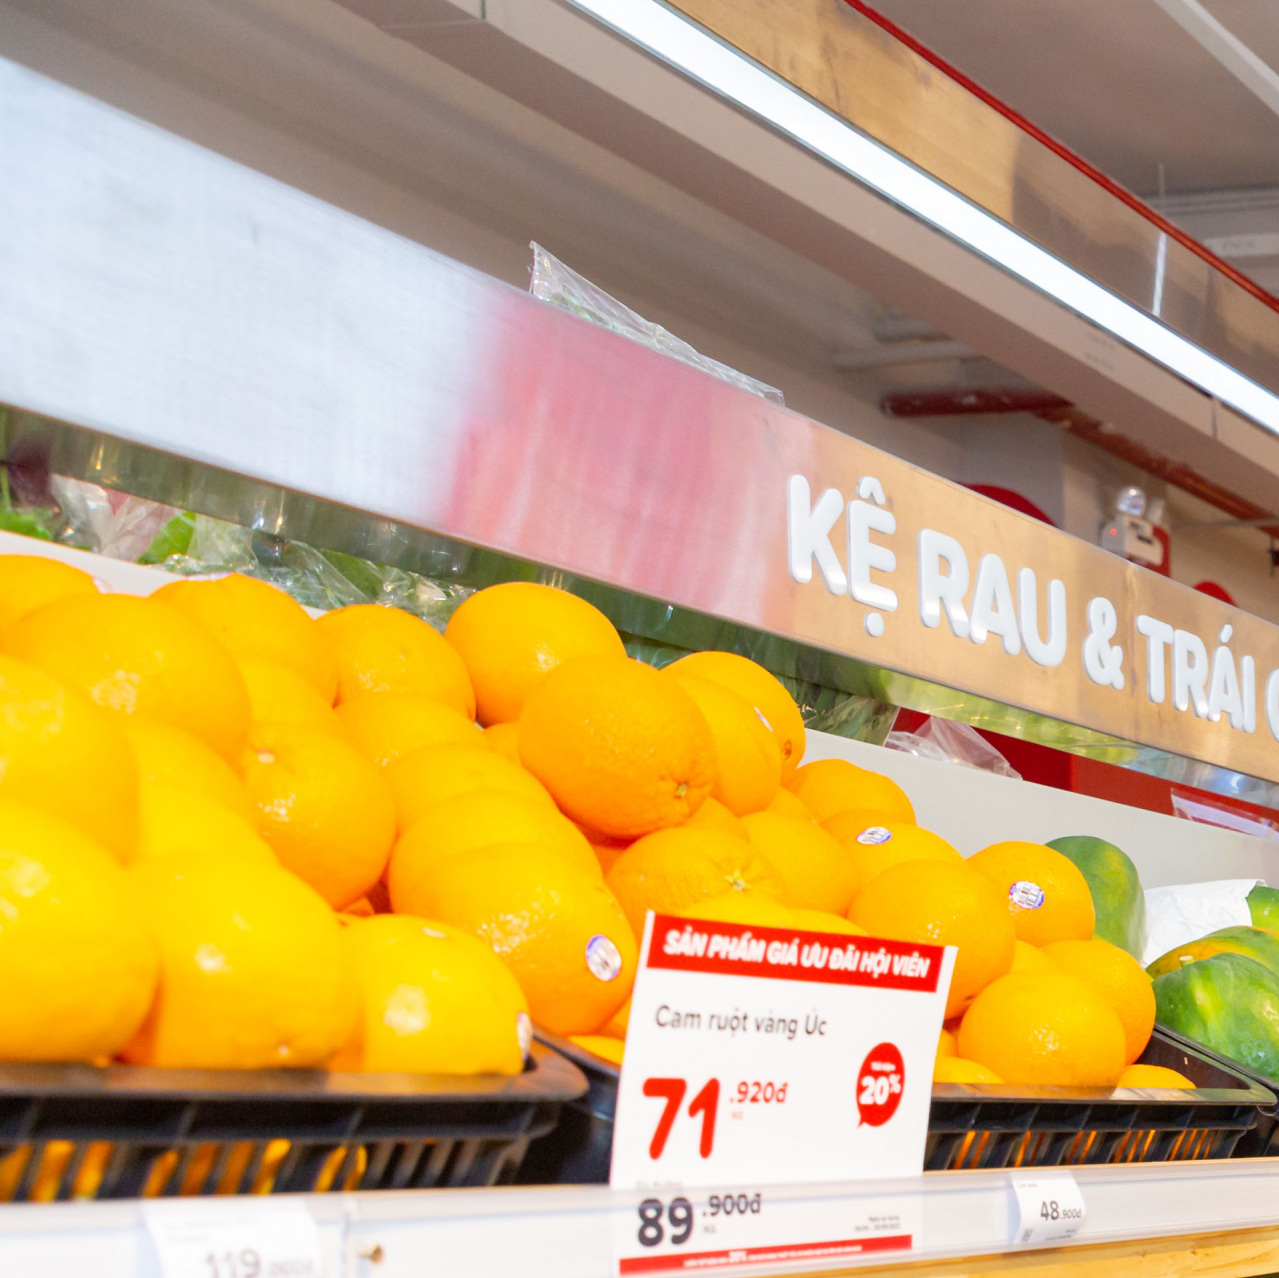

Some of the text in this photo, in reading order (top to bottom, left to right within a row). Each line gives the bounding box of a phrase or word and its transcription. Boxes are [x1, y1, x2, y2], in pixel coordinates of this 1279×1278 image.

[787, 474, 898, 636] KỆ
[917, 528, 1067, 668] RAU
[1082, 597, 1124, 689] &
[1136, 615, 1256, 733] TRÁI
[663, 925, 930, 978] SẢN PHẨM GIÁ ƯU ĐÃI HỘI VIÊN
[655, 1005, 827, 1040] Cam ruột vàng Úc
[859, 1073, 901, 1106] 20%
